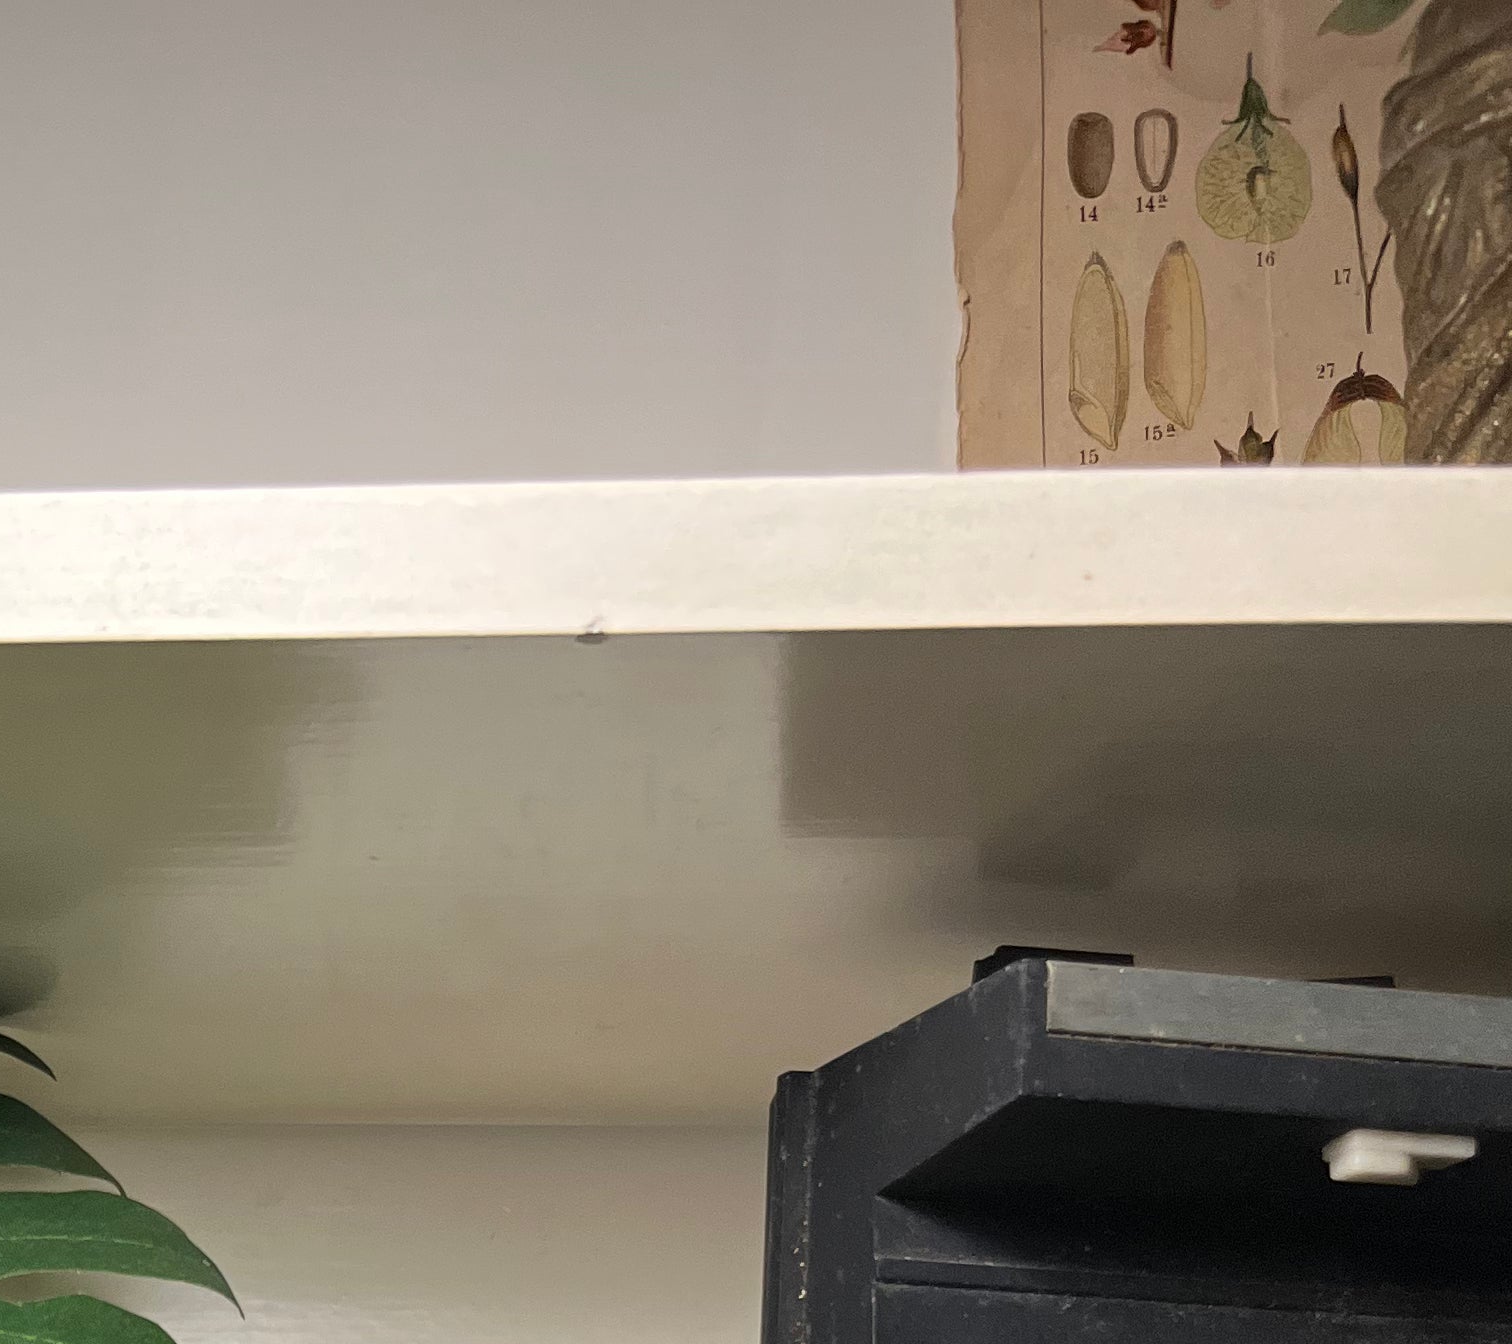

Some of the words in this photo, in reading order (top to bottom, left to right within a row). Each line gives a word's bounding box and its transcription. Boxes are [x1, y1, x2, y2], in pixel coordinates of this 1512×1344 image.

[1079, 205, 1099, 222] 14
[1255, 250, 1276, 268] 16
[1333, 268, 1352, 286] 17
[1316, 362, 1336, 379] 27
[1079, 449, 1100, 466] 15
